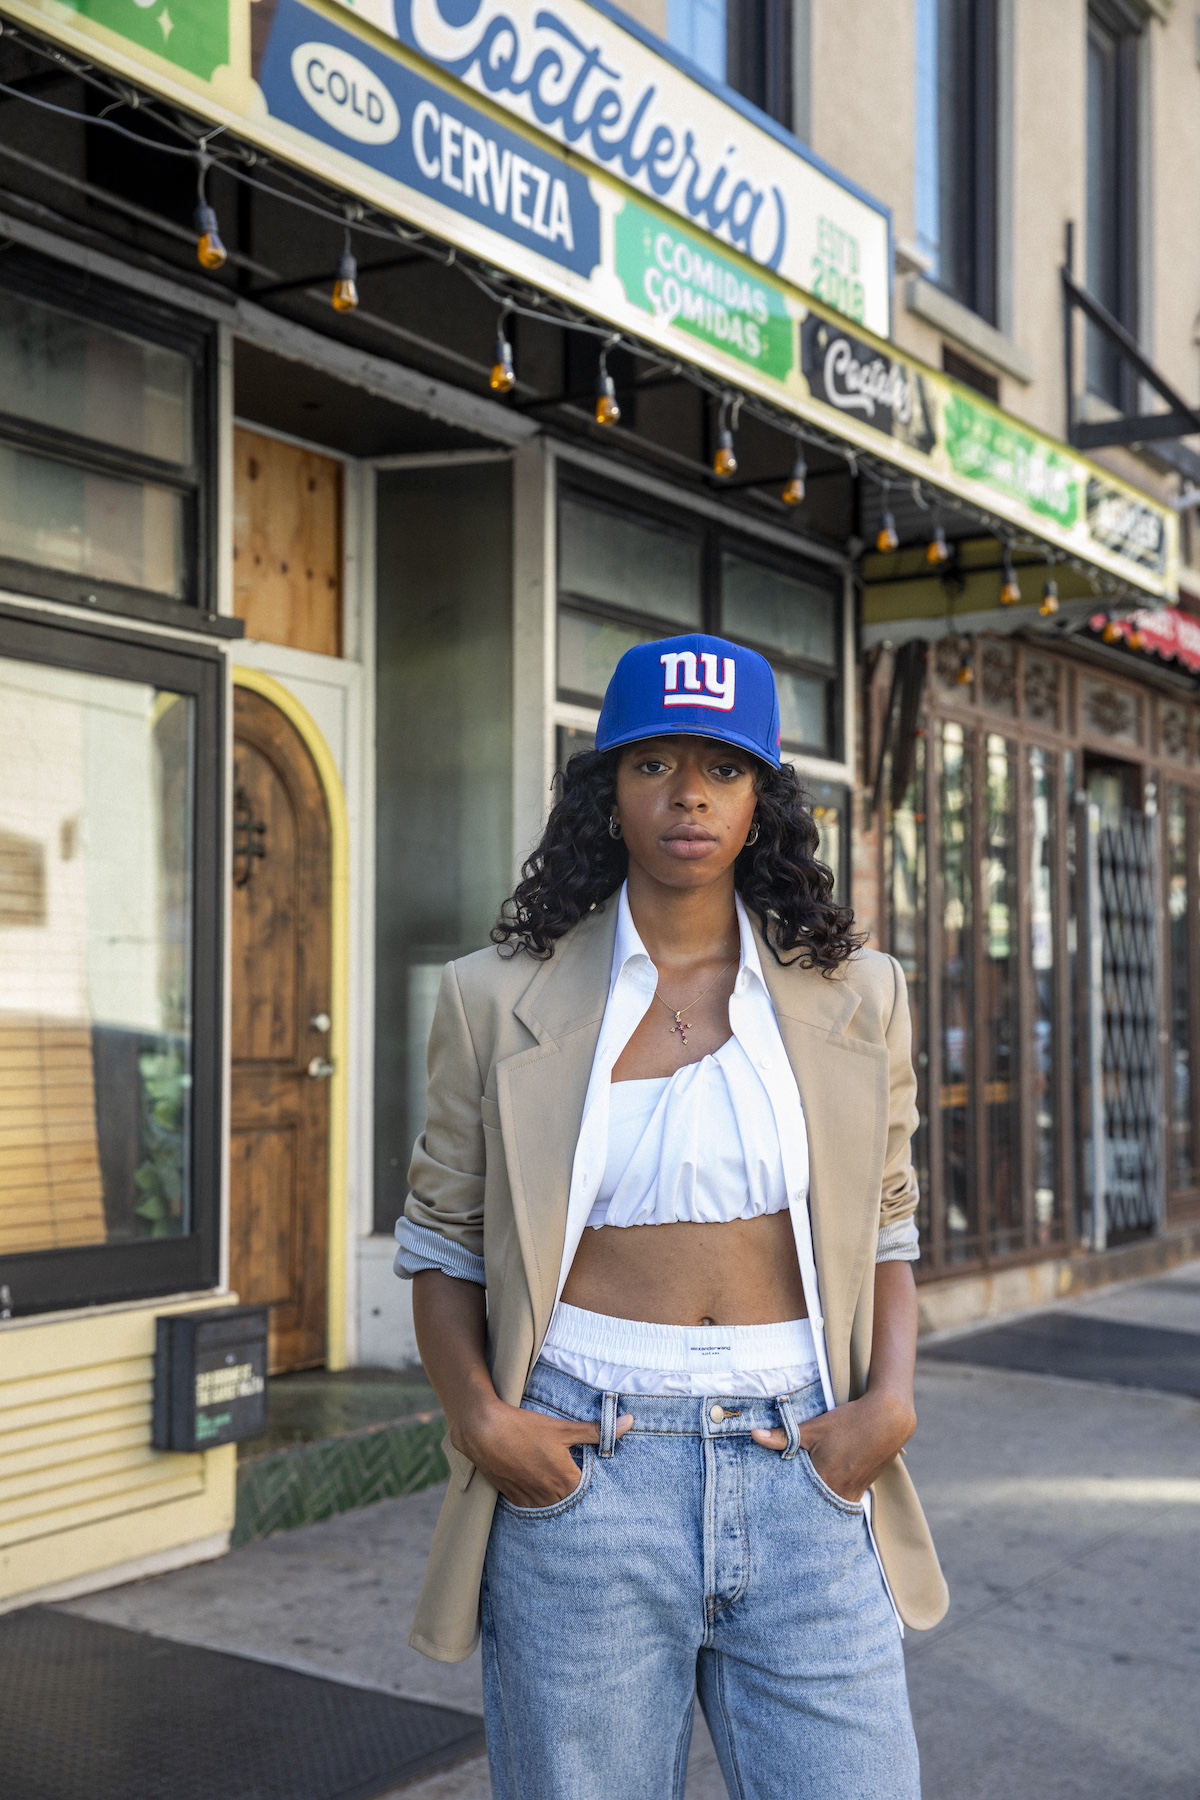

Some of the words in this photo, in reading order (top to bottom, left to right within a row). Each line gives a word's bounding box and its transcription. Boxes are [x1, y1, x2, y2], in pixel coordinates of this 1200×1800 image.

[307, 57, 384, 125] COLD
[411, 99, 575, 252] CERVEZA
[643, 267, 761, 359] COMIDAS
[654, 232, 769, 325] COMIDAS
